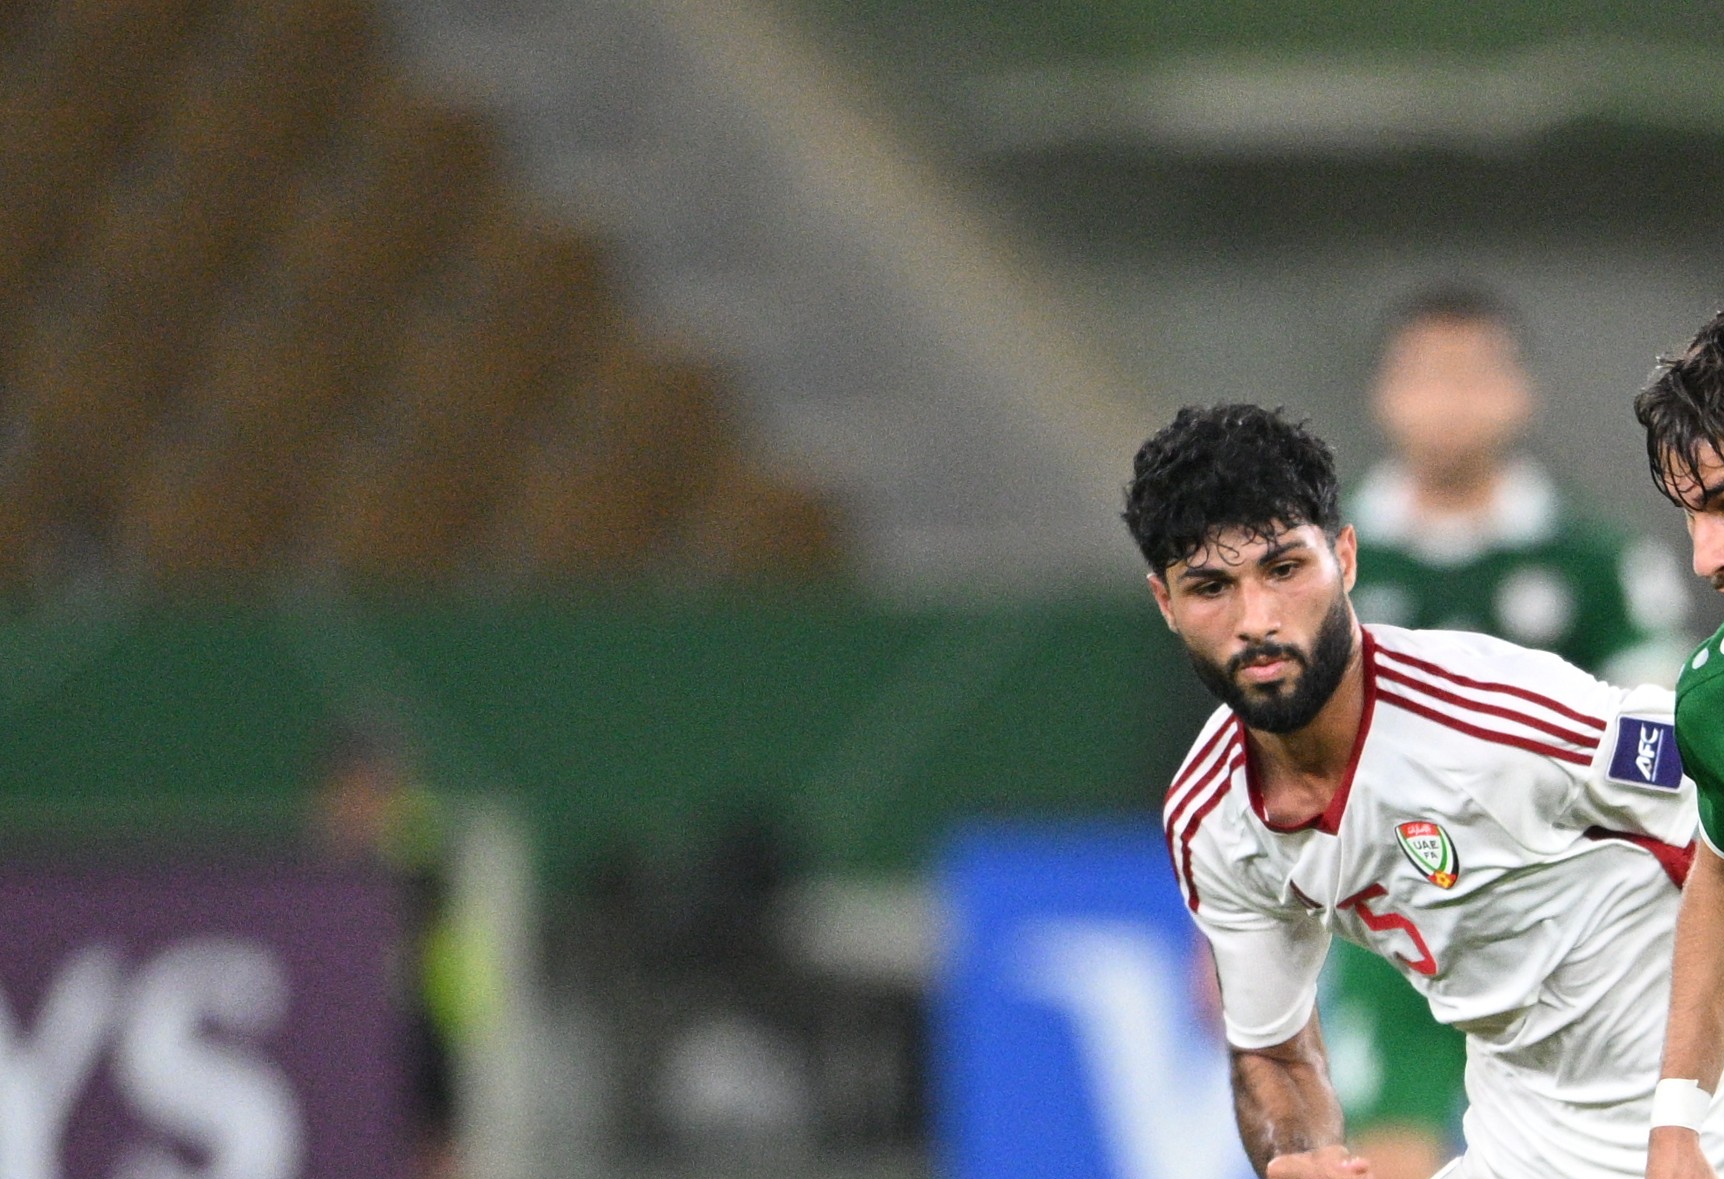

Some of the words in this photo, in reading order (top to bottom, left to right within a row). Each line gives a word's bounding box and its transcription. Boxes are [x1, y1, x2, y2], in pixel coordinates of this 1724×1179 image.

[1635, 722, 1659, 781] AFC
[1413, 840, 1439, 850] UAE
[1336, 882, 1437, 976] 5
